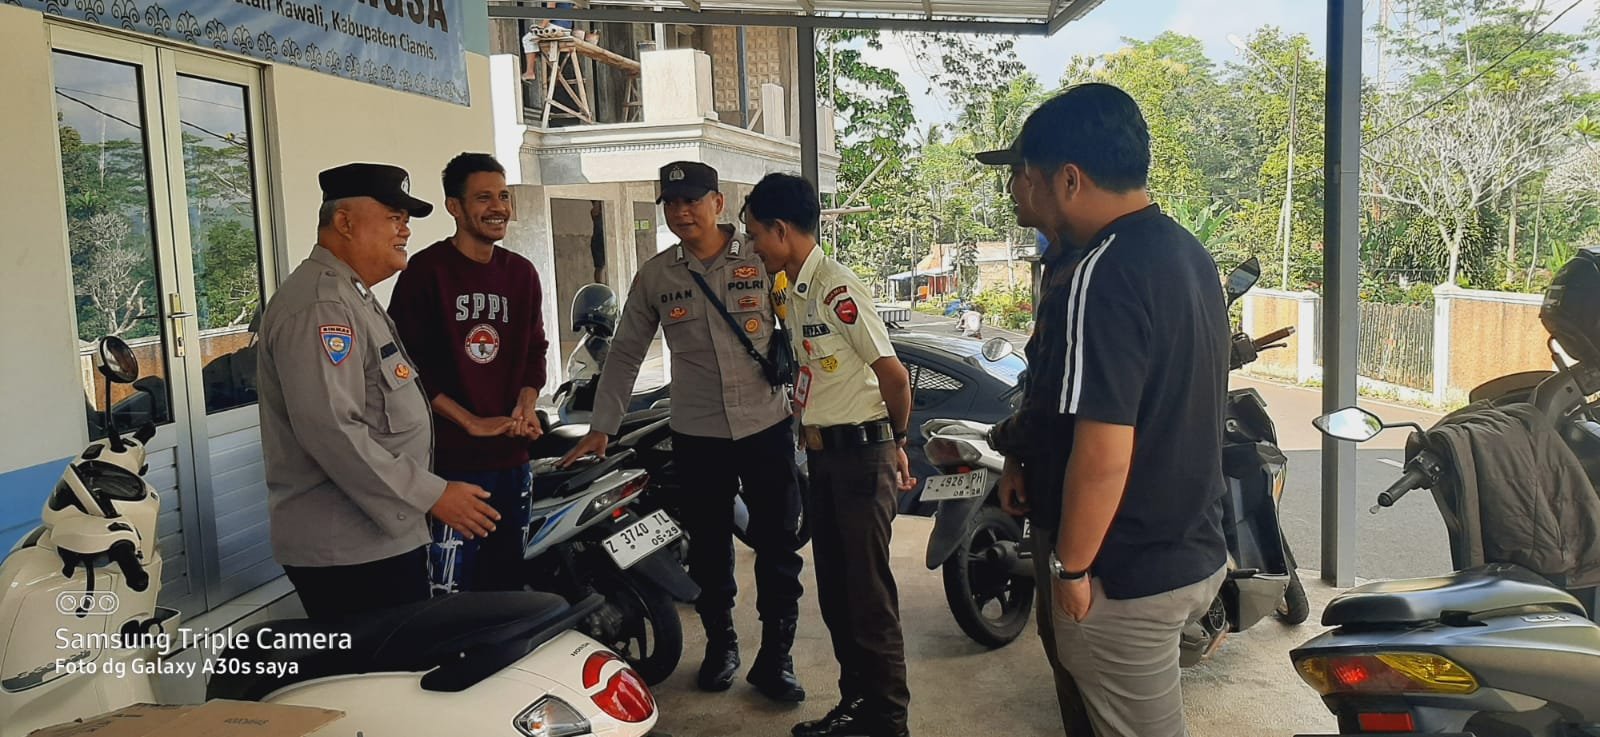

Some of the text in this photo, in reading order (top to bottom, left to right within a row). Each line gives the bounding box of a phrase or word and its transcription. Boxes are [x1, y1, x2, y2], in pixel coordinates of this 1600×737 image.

[275, 0, 329, 32] Kawali,
[331, 10, 397, 48] Kabupaten
[400, 33, 437, 60] Ciamis.
[358, 0, 449, 33] SA
[660, 290, 692, 303] DIAN
[727, 280, 765, 291] POLRI
[455, 292, 509, 323] SPPI
[970, 471, 983, 484] PH
[605, 512, 670, 554] Z 3740 TL
